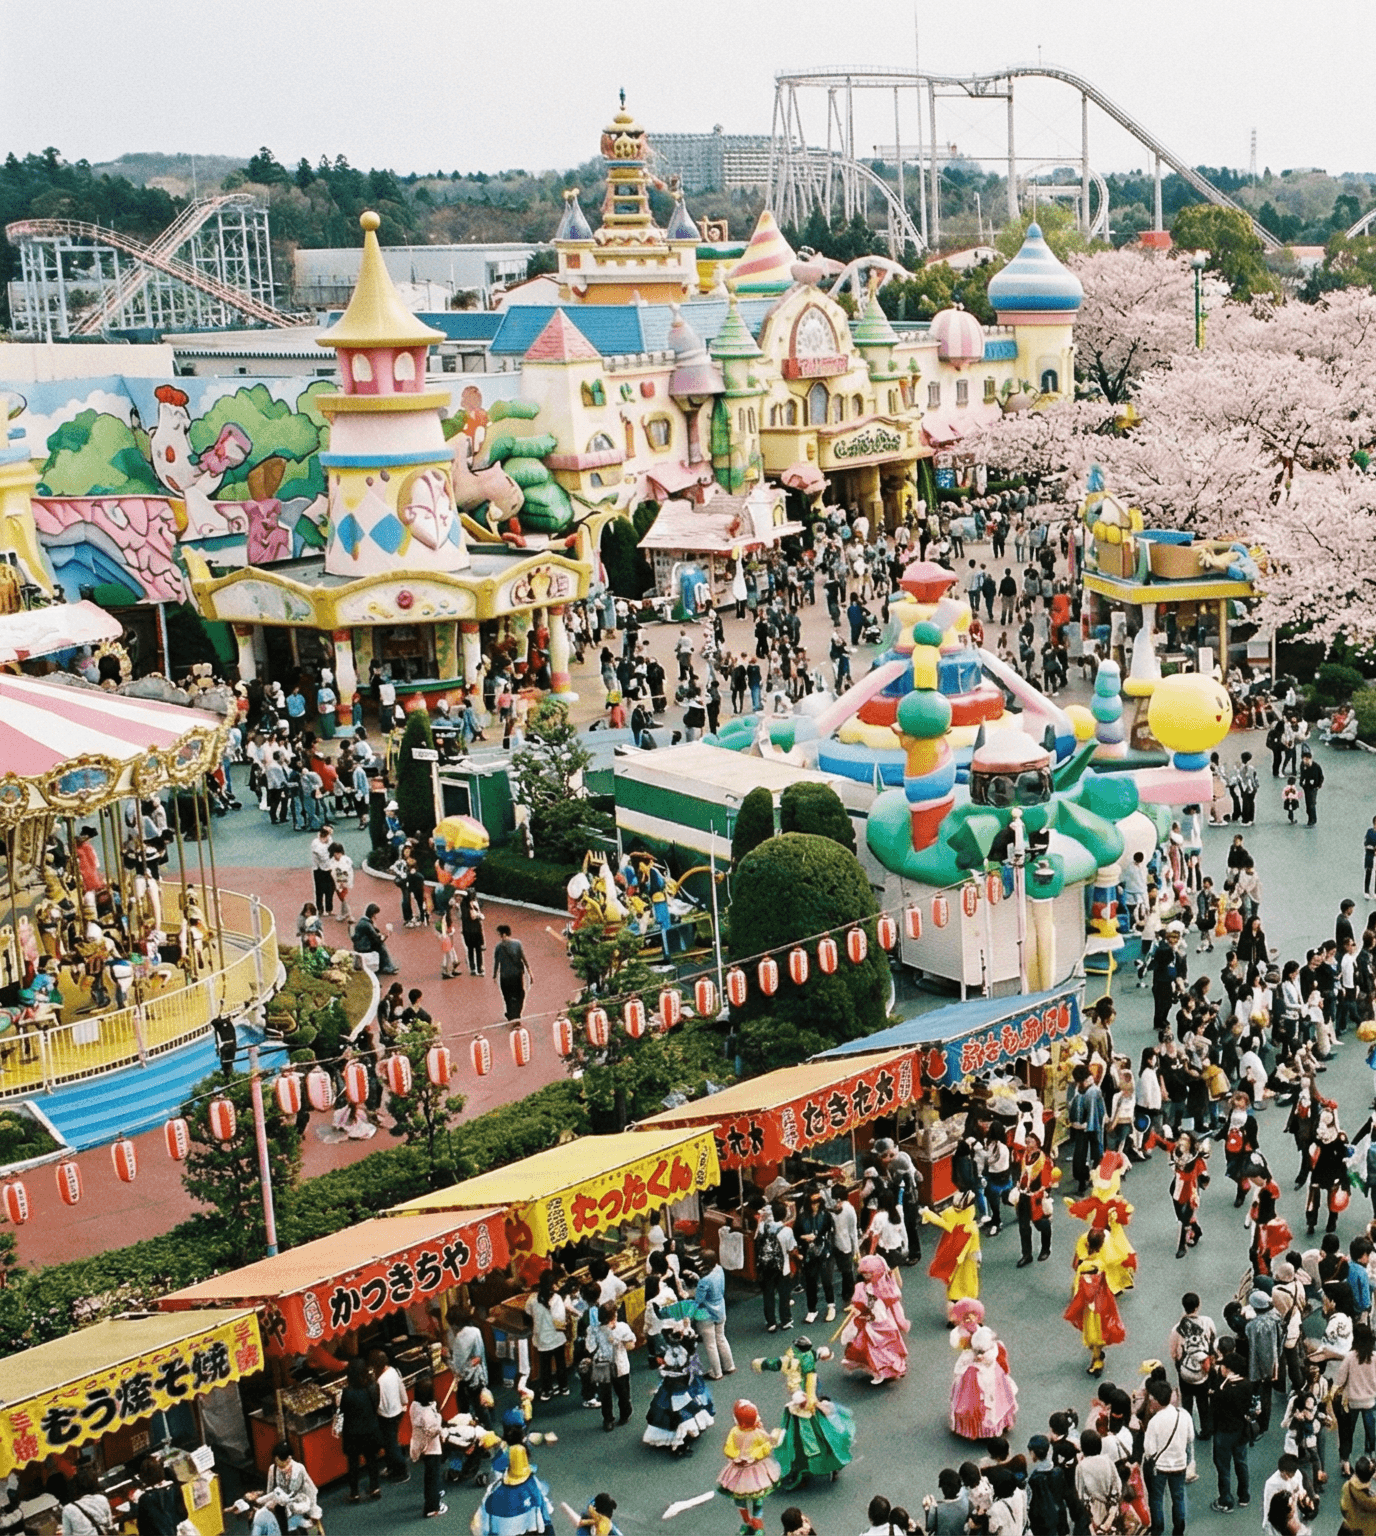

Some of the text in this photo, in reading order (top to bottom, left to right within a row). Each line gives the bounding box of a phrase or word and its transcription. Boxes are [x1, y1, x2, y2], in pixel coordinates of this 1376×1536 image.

[329, 1239, 471, 1330] かつきちや
